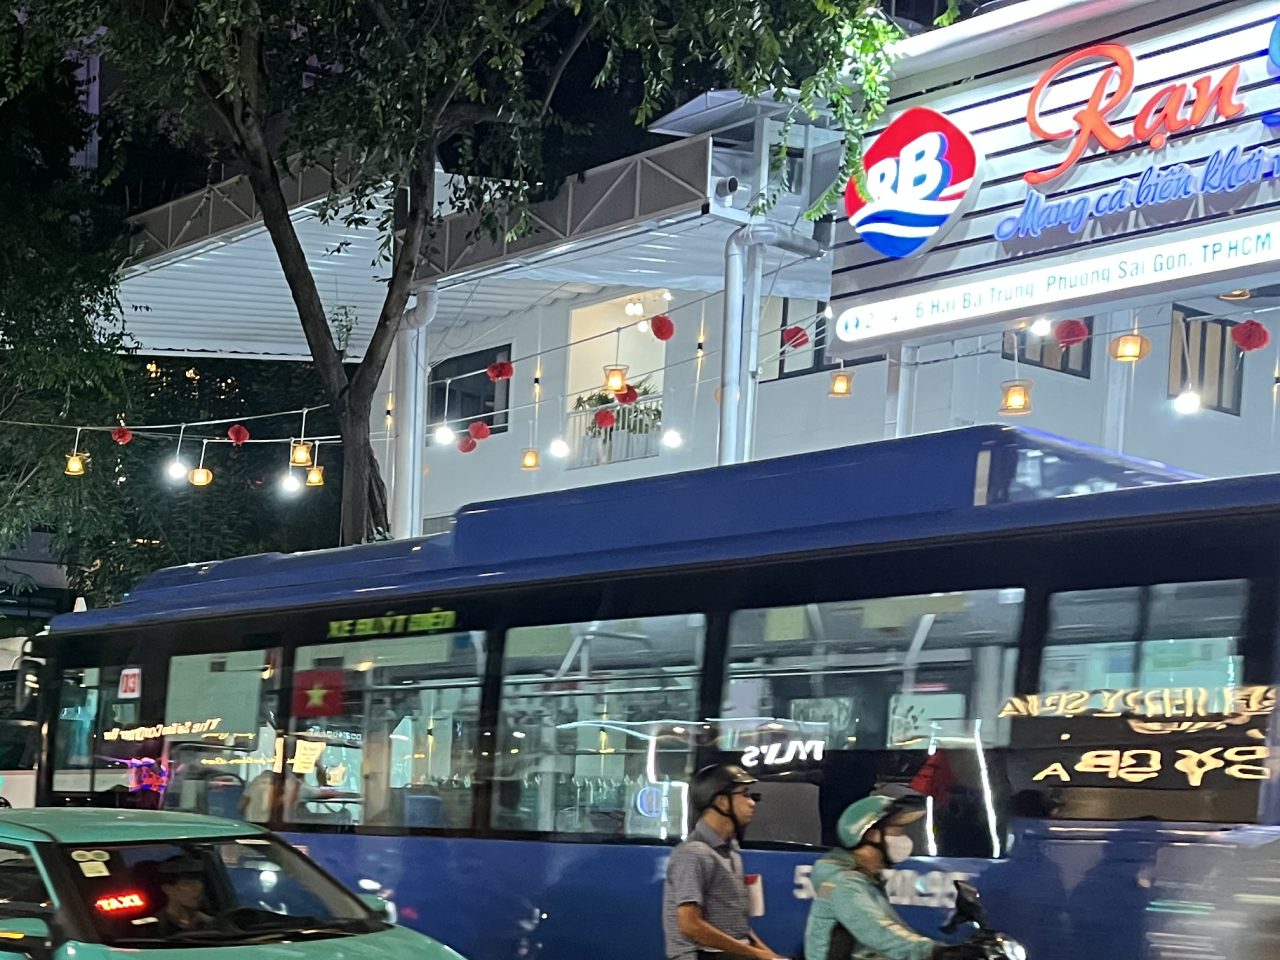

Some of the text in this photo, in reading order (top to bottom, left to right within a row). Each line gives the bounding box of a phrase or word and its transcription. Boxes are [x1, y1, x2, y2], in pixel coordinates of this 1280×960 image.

[1024, 43, 1246, 186] Rạn
[995, 190, 1088, 239] Mang
[95, 894, 144, 911] TAXI
